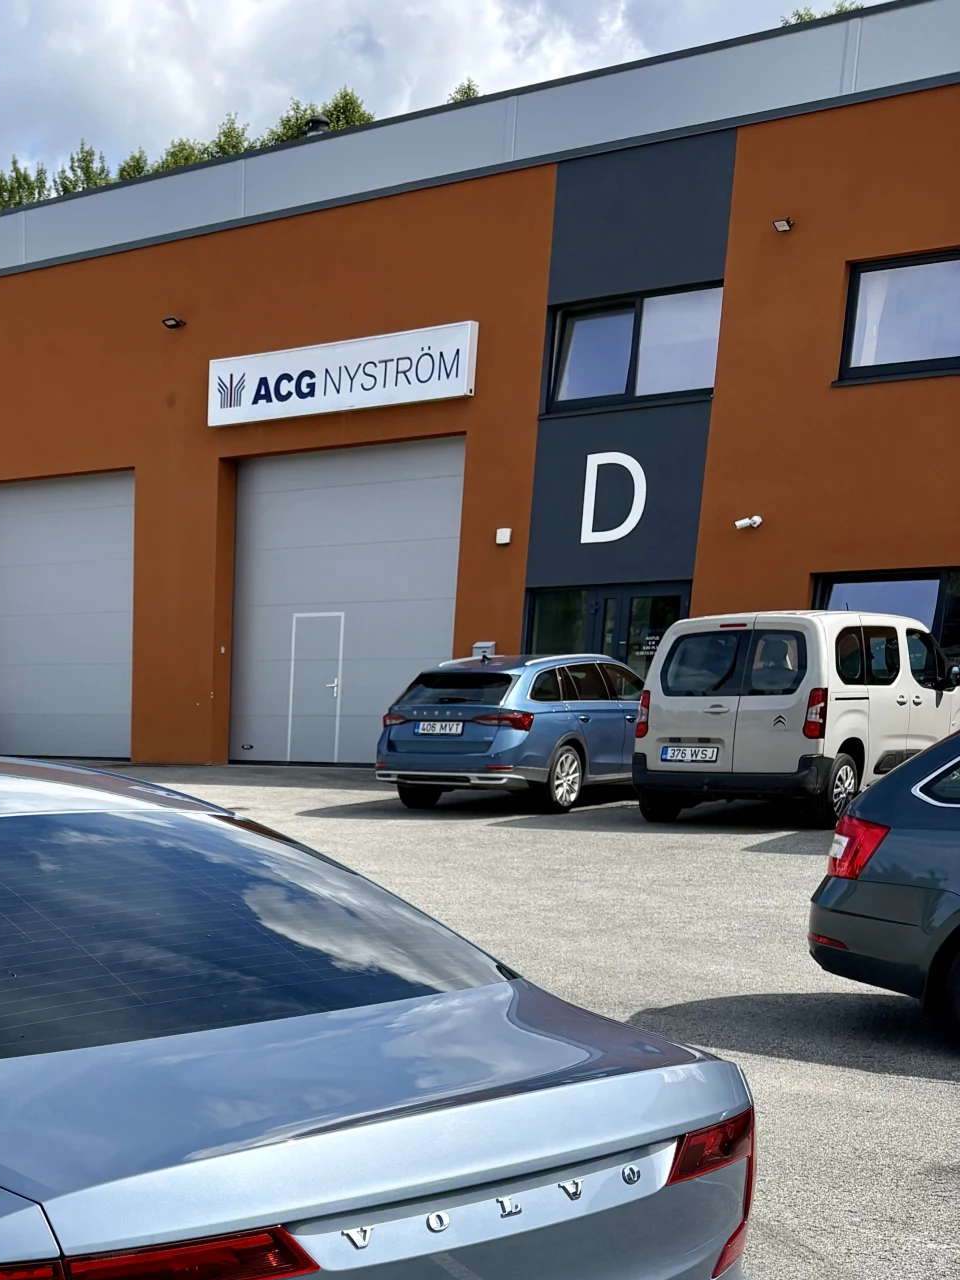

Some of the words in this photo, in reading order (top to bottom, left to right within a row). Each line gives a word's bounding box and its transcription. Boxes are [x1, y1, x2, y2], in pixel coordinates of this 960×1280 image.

[252, 370, 316, 405] ACG
[323, 345, 460, 396] NYSTRÖM
[580, 451, 647, 544] D
[421, 723, 436, 732] 406
[440, 723, 460, 732] MVT
[670, 748, 687, 759] 376
[690, 748, 715, 760] WSJ
[341, 1164, 641, 1249] VOLVO
